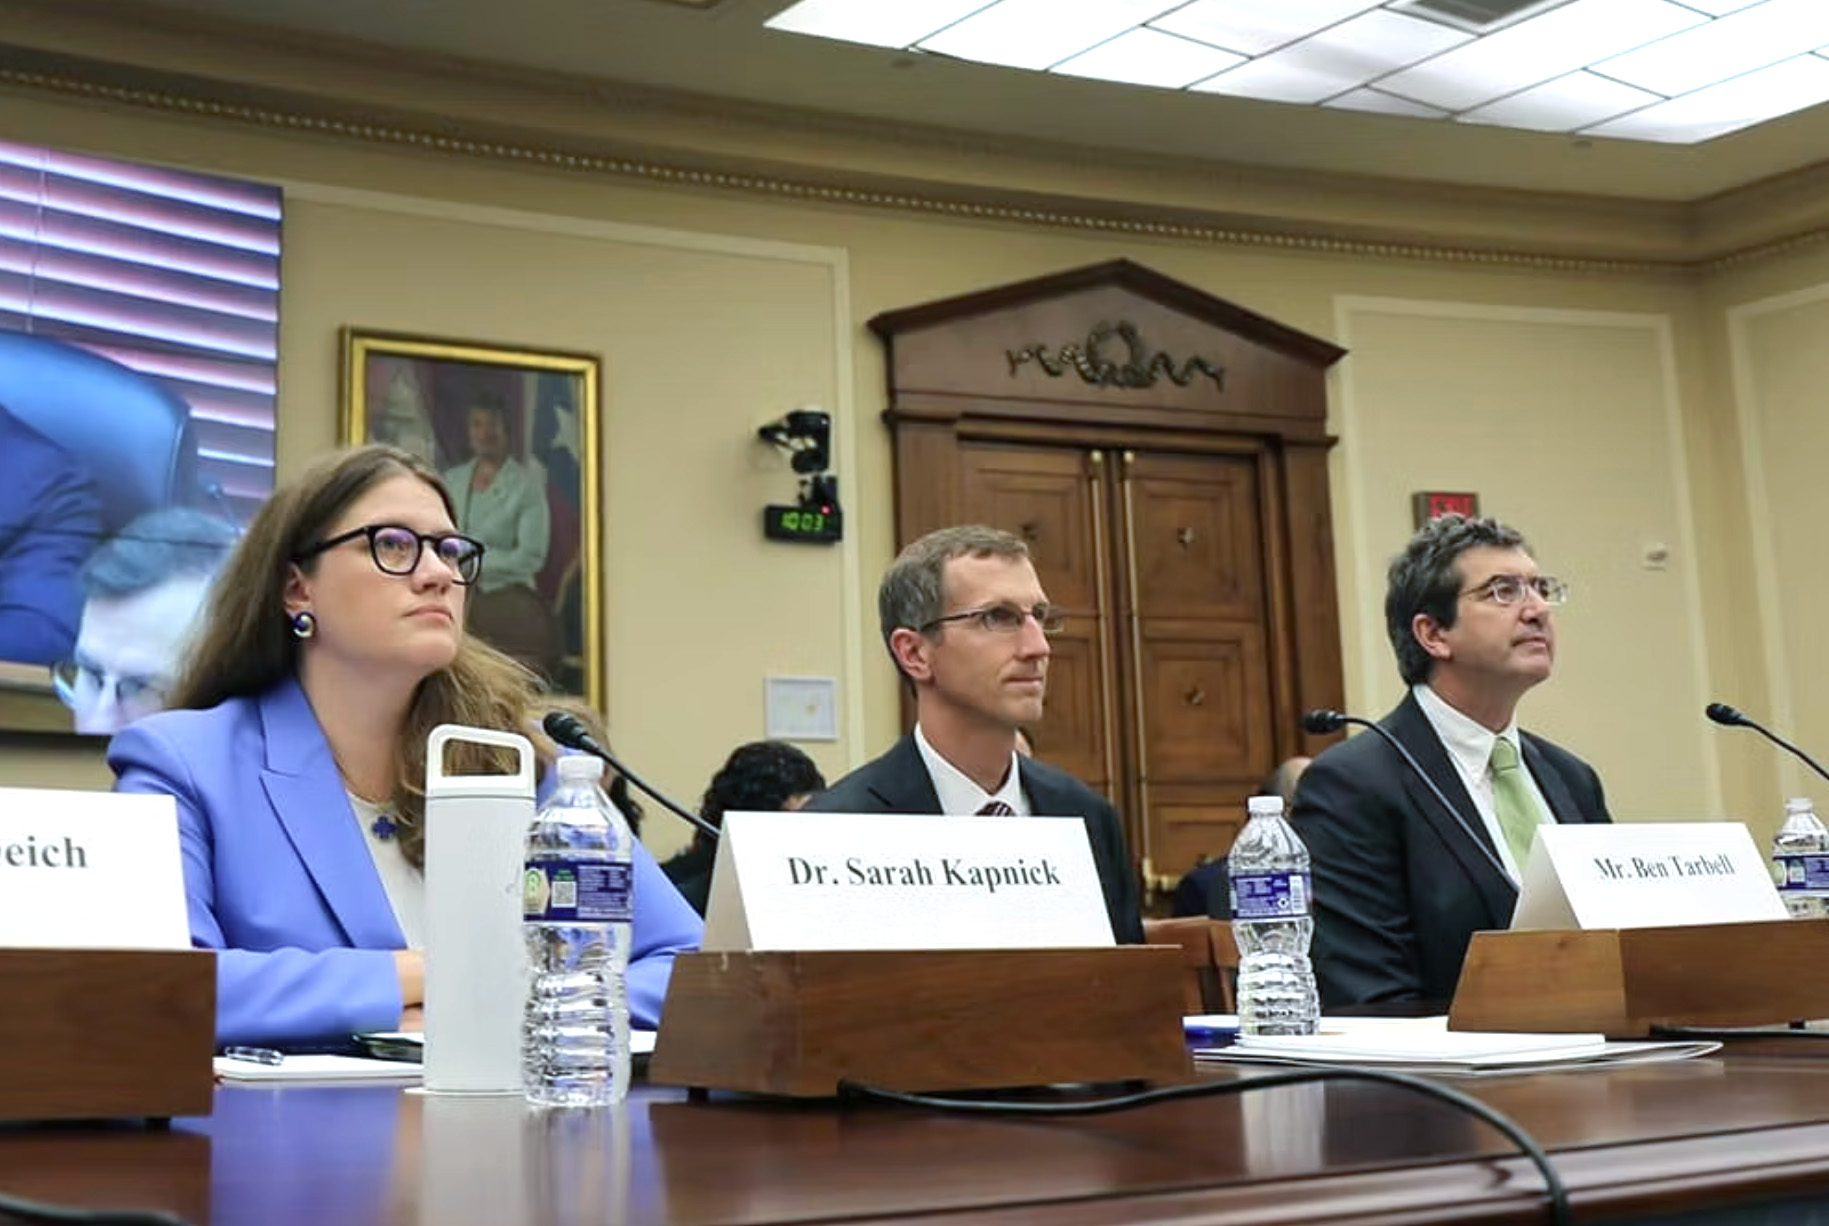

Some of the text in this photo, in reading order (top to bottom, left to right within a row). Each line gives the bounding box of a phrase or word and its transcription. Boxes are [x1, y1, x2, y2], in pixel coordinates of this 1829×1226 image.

[0, 835, 88, 868] eich
[1594, 854, 1736, 879] Mr. Ben Tarbell
[788, 857, 1061, 893] Dr. Sarah Kapnick
